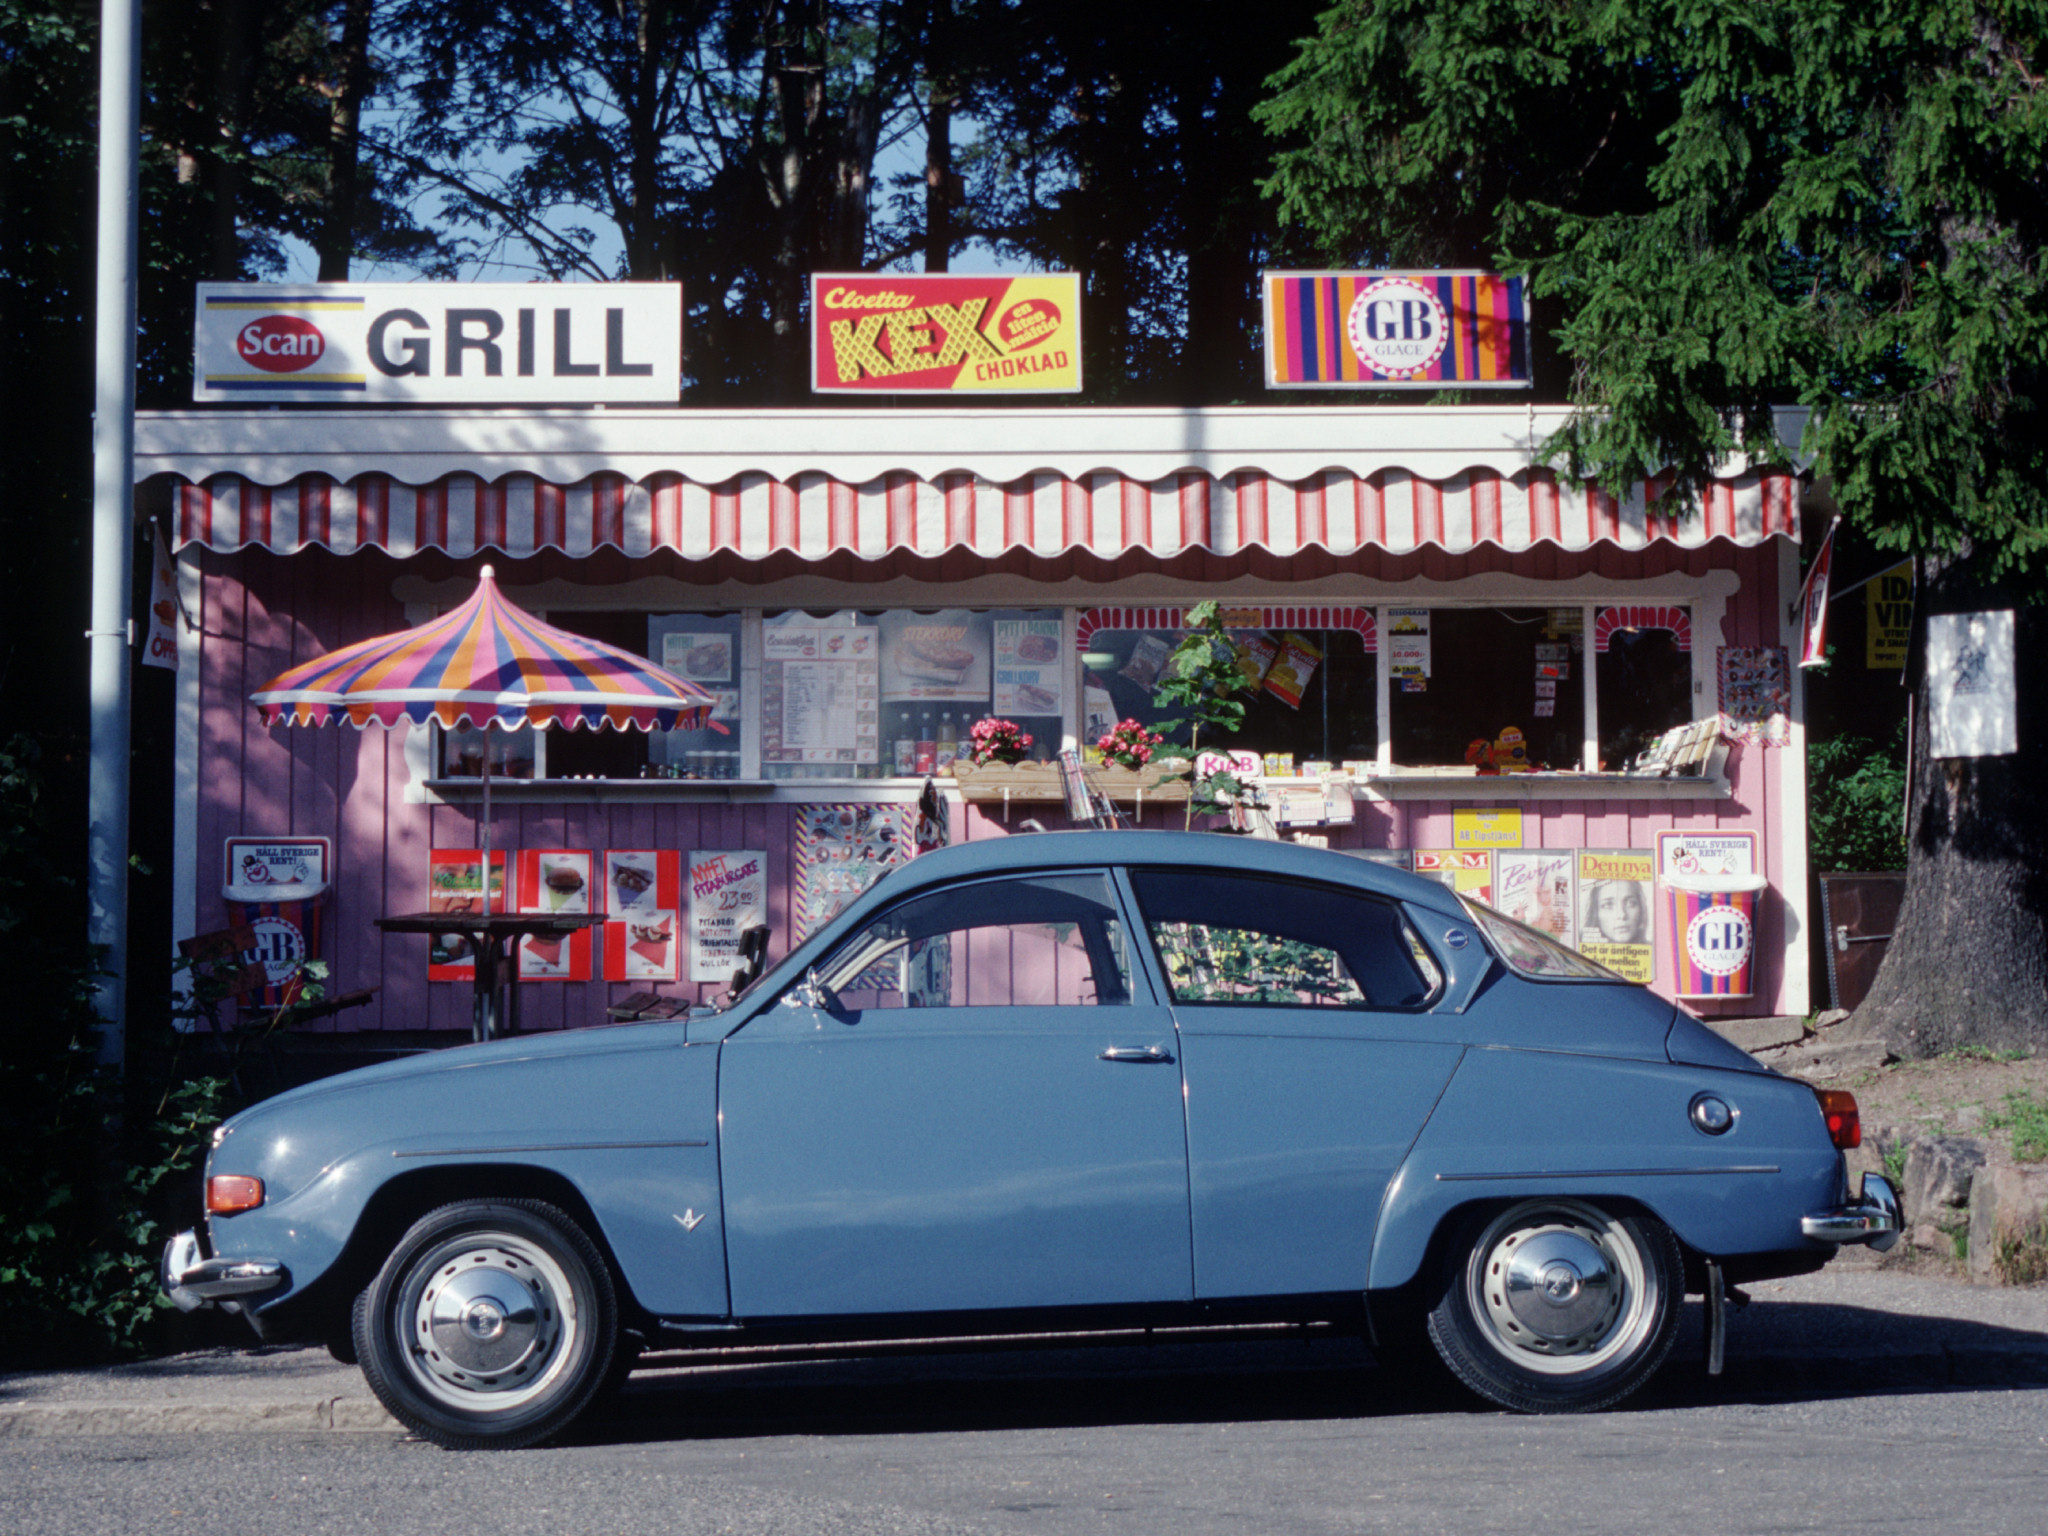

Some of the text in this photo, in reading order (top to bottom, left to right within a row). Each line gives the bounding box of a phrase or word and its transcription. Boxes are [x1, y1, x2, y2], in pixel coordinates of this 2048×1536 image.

[824, 286, 916, 309] Cloetta
[1012, 302, 1034, 318] en
[1006, 310, 1048, 335] liten
[1365, 299, 1433, 341] GB
[243, 325, 321, 356] Scan
[829, 297, 1006, 383] KEX
[1008, 315, 1061, 349] måltid
[367, 308, 654, 378] GRILL
[1374, 344, 1424, 356] GLACE
[975, 350, 1069, 382] CHOKLAD
[1459, 830, 1471, 841] AB
[1685, 839, 1748, 849] HÅLL SVERIGE
[255, 846, 319, 857] HÅLL SVERIGE
[269, 856, 297, 865] RENT!
[1415, 854, 1488, 867] DAM
[1698, 848, 1726, 857] RENT!
[690, 854, 728, 885] NYHET
[1582, 856, 1651, 879] Den nya
[1698, 922, 1744, 950] GB
[1581, 944, 1650, 958] Det är äntligen
[1703, 952, 1737, 961] GLACE
[1608, 956, 1641, 967] mellan
